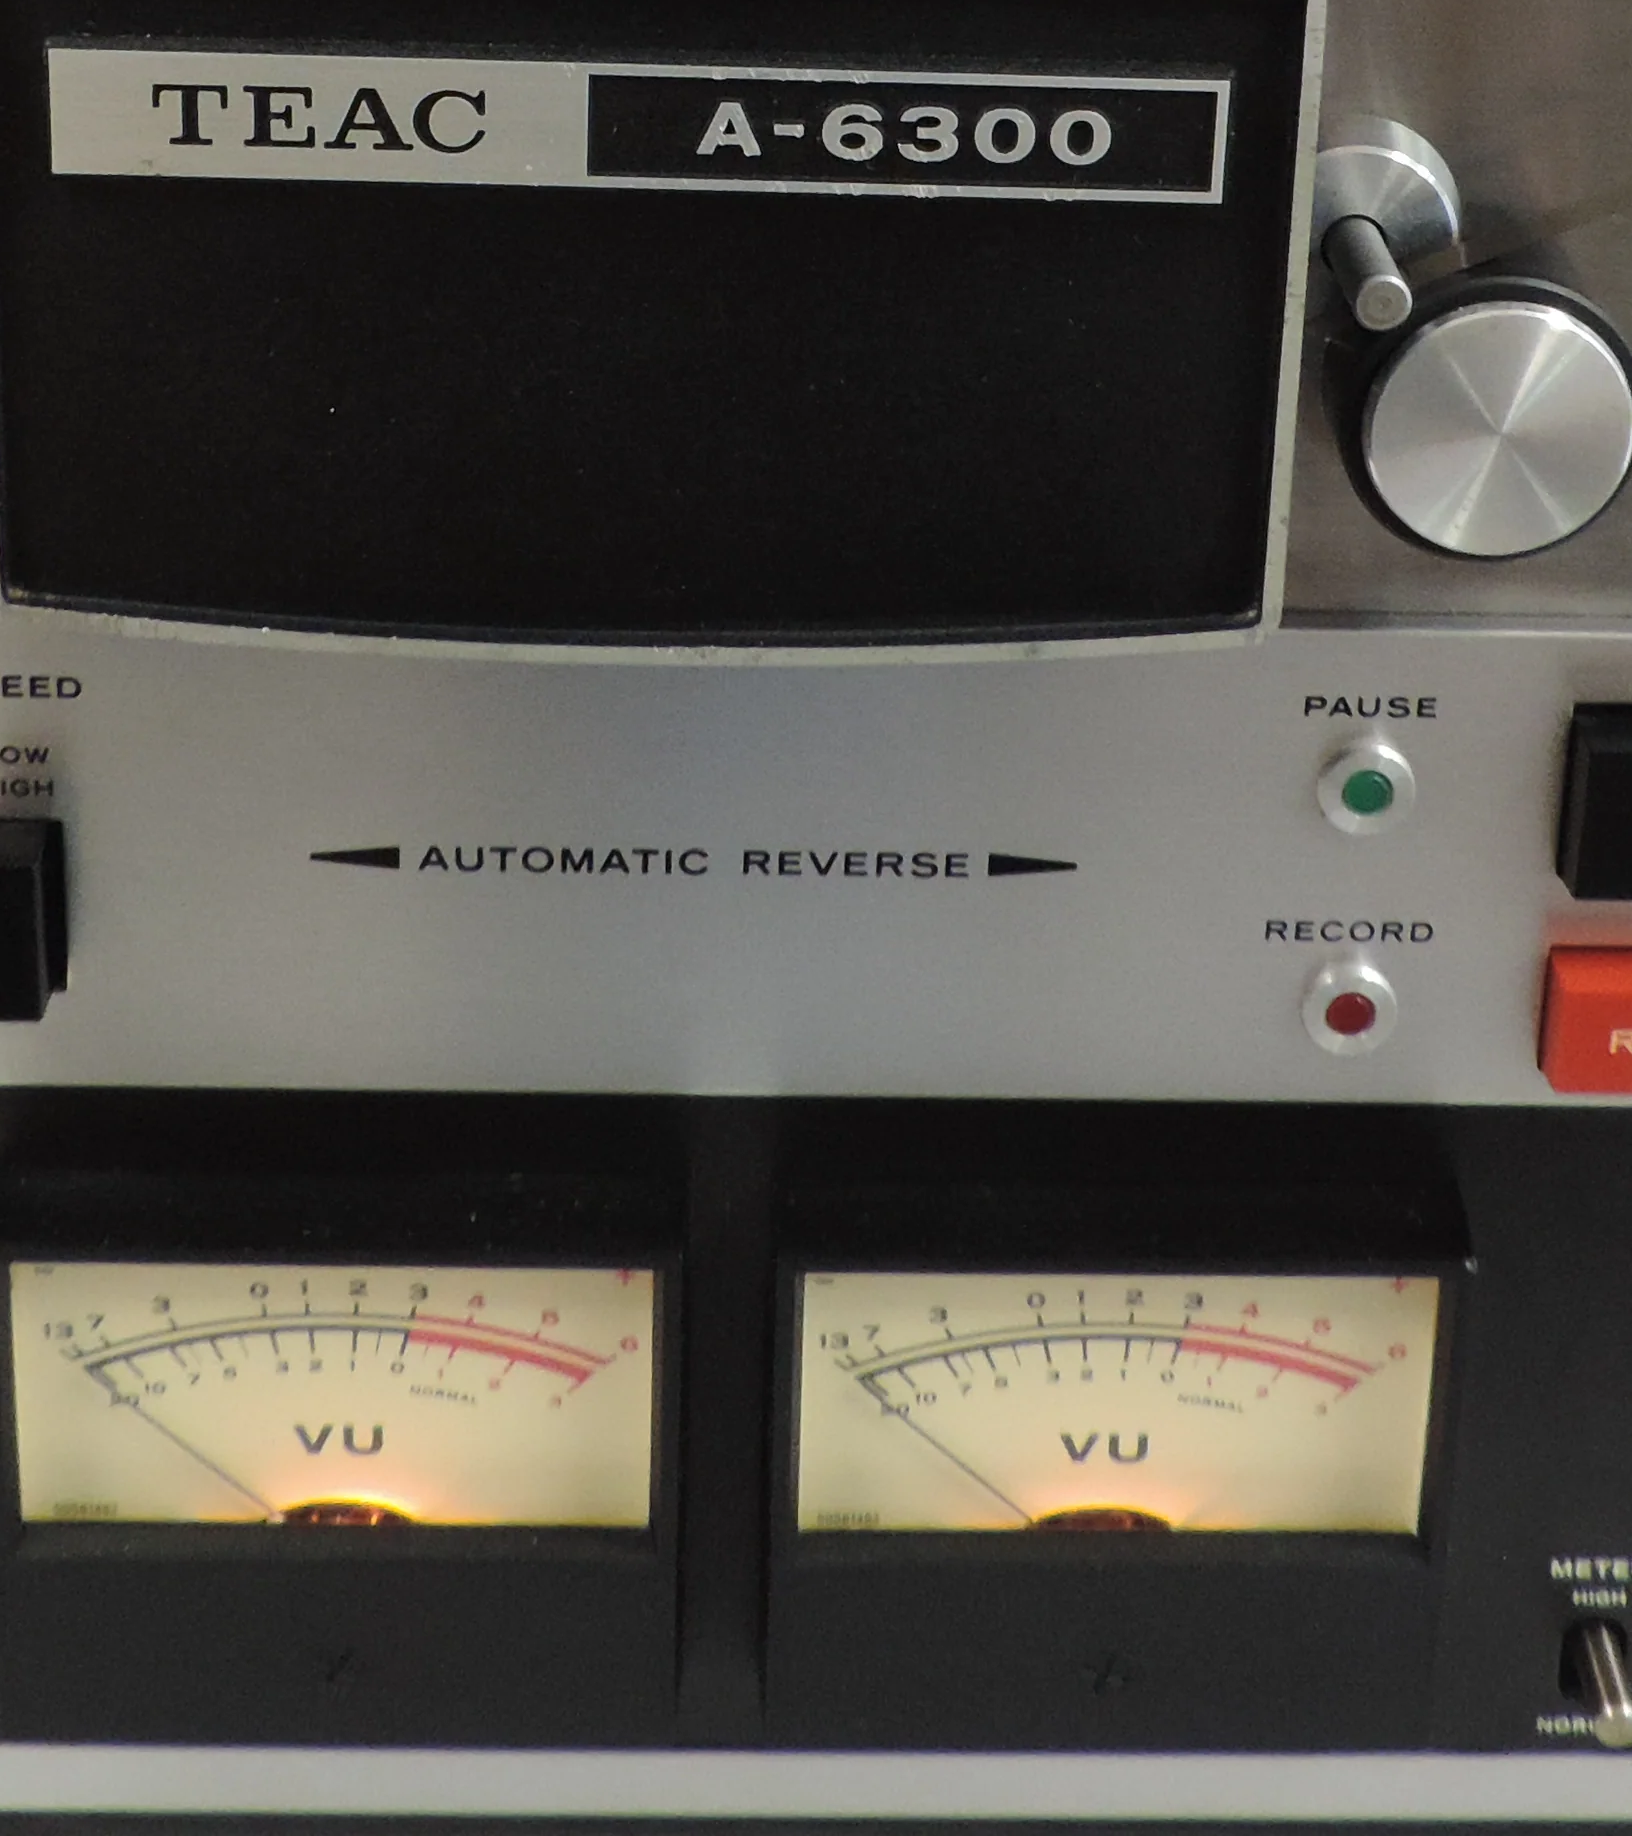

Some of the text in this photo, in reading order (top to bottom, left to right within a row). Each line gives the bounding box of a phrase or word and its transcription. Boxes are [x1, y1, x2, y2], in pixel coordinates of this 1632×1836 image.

[152, 84, 1114, 166] TEAC A-6300
[1303, 696, 1438, 720] PAUSE
[418, 845, 970, 878] AUTOMATIC REVERSE
[1264, 920, 1435, 944] RECORD
[294, 1424, 384, 1456] VU
[1060, 1432, 1149, 1464] VU
